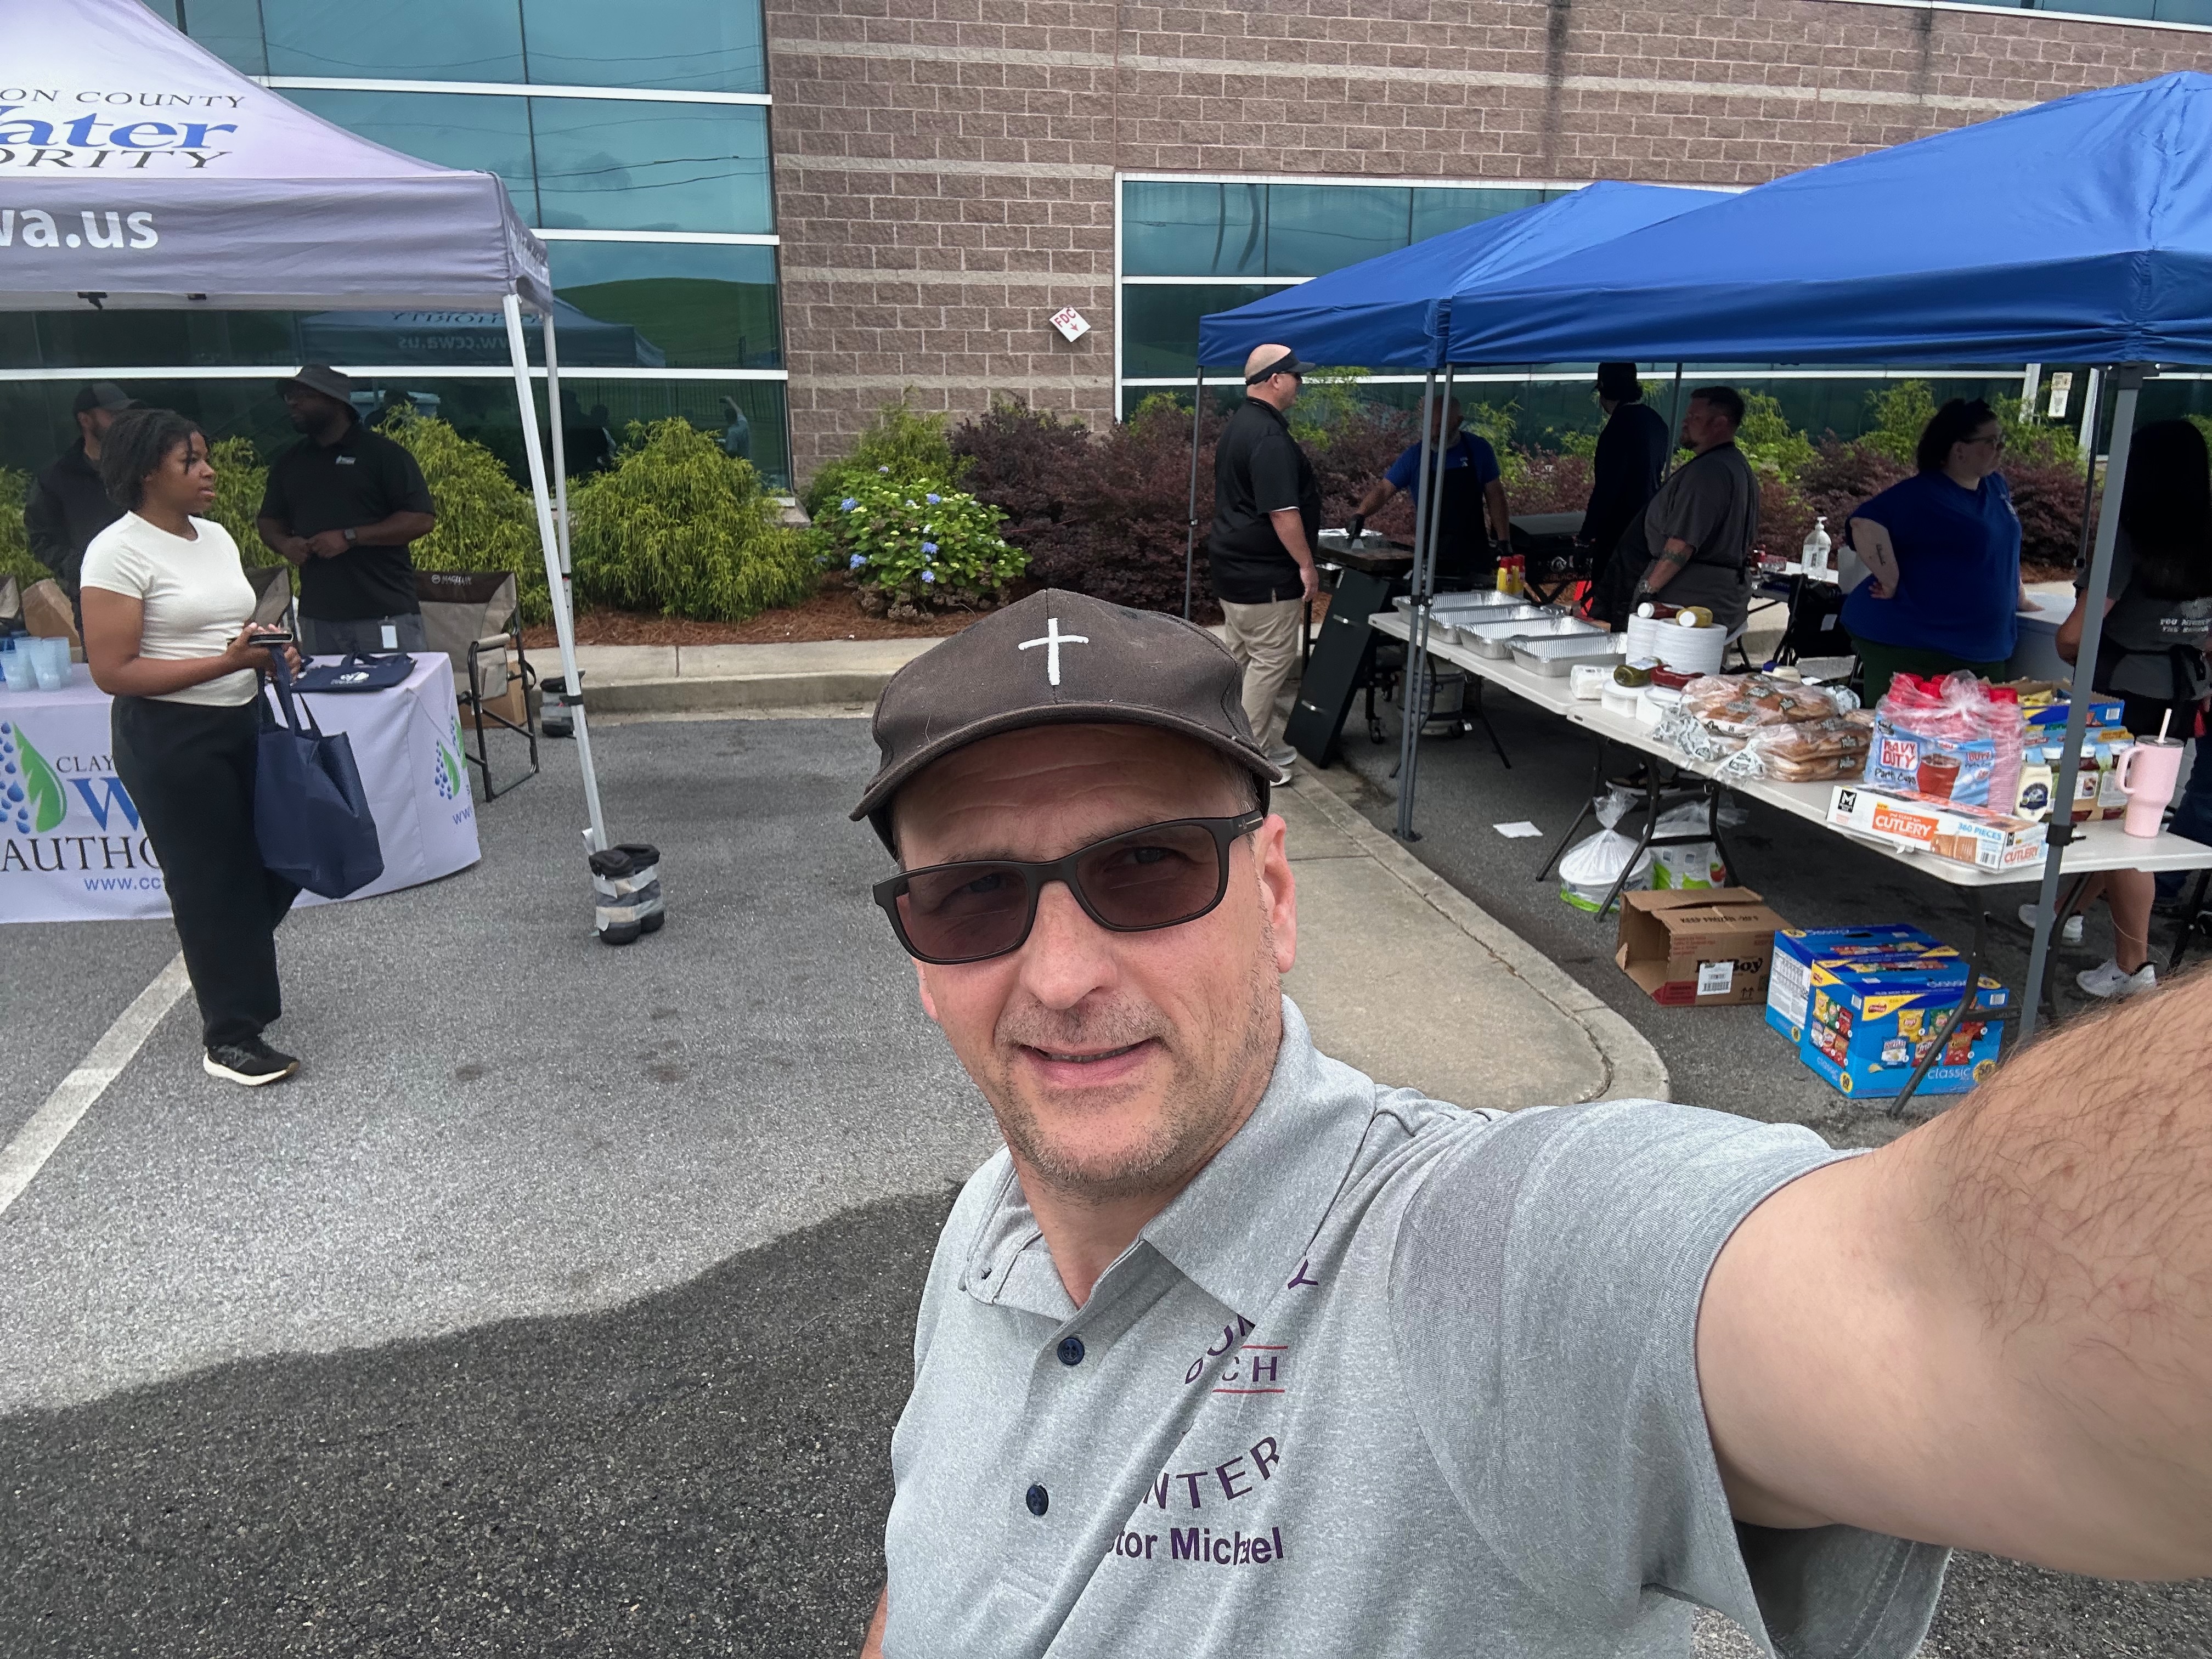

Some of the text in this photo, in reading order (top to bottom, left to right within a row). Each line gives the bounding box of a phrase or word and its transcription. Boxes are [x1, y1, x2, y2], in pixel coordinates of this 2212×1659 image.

[76, 91, 245, 108] COUNTY
[0, 106, 239, 149] ater
[1054, 308, 1076, 328] FDC
[57, 755, 113, 772] CLAY
[1882, 751, 1916, 768] DUTY
[1875, 815, 1932, 838] CUTLERY
[1974, 826, 2002, 841] PIECES
[2004, 846, 2039, 864] CUTLERY
[84, 878, 161, 890] www.cc
[1927, 1066, 1971, 1079] classic
[1107, 1531, 1158, 1559] tor
